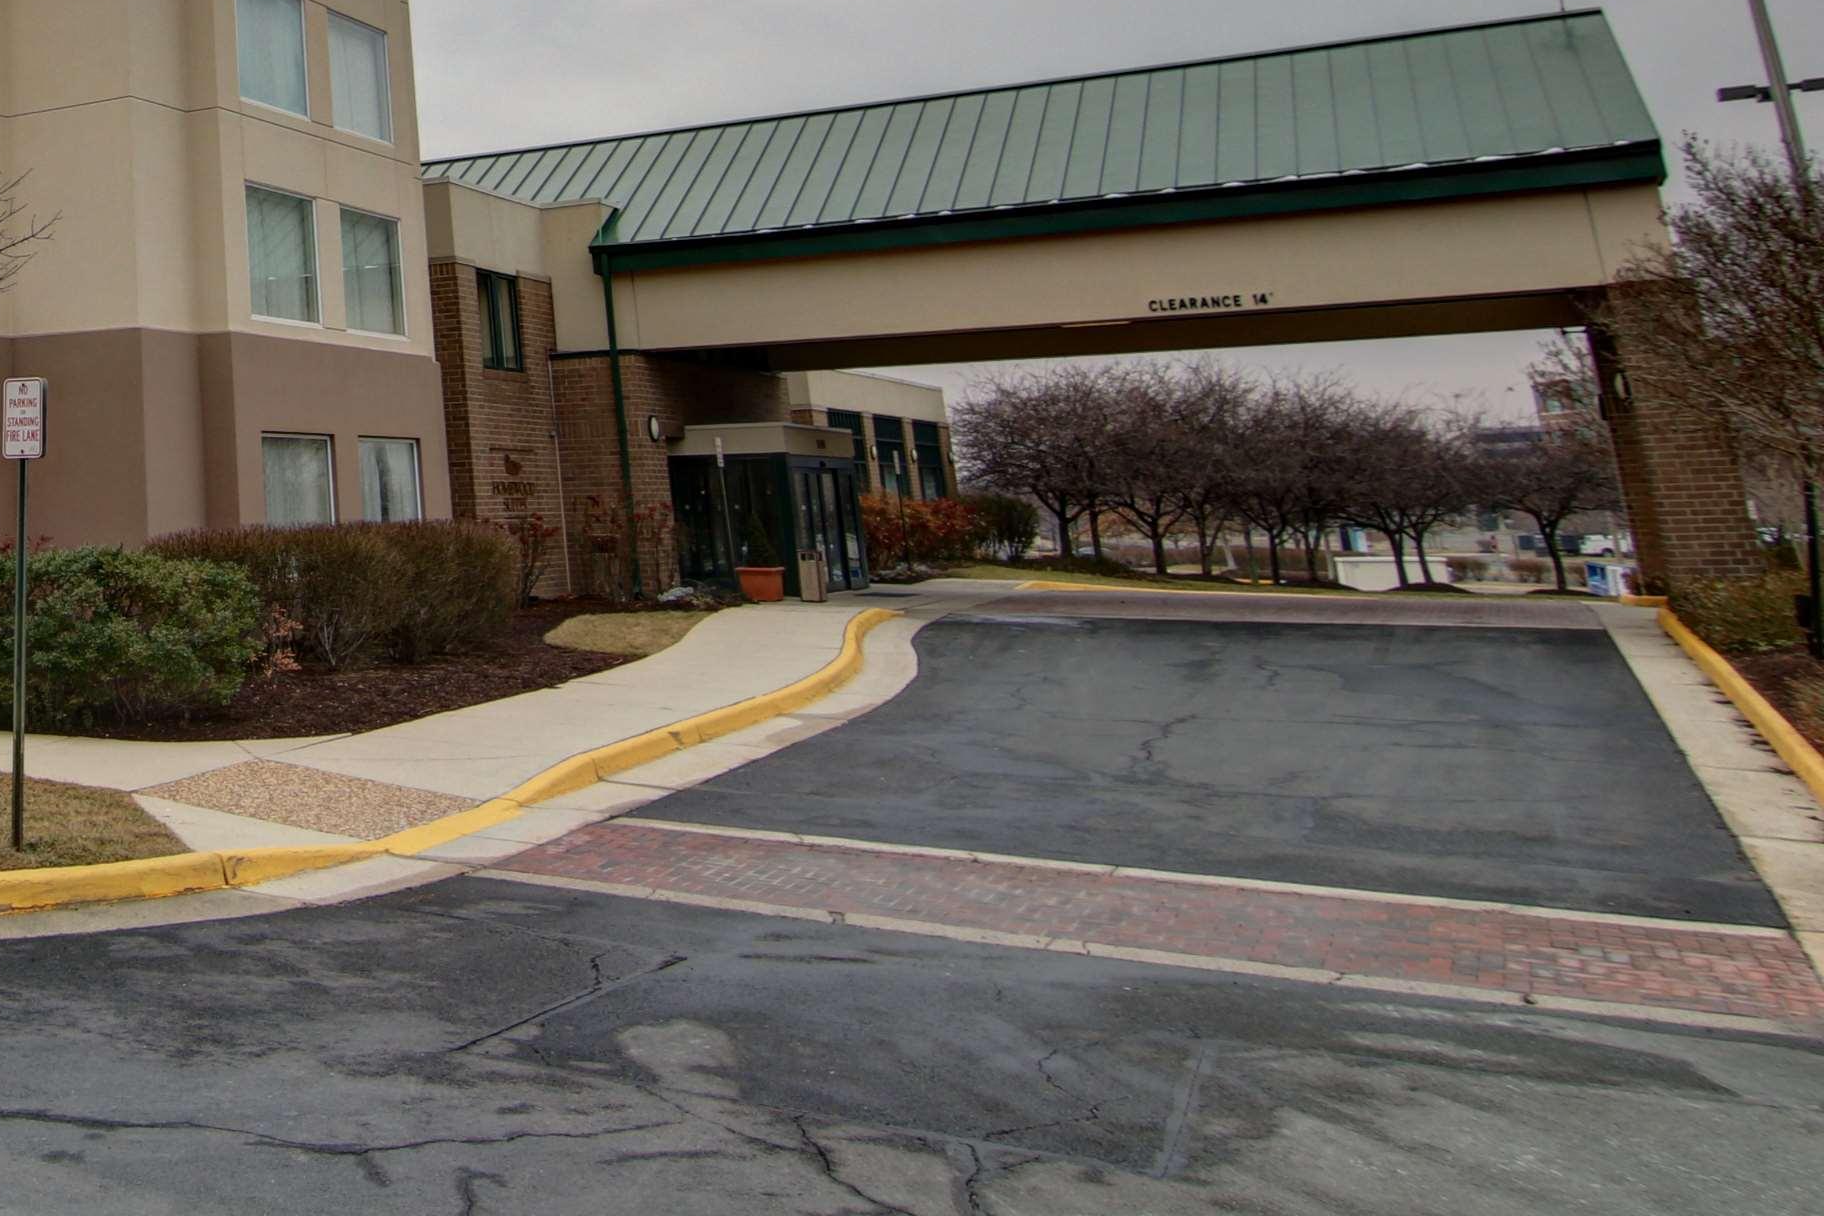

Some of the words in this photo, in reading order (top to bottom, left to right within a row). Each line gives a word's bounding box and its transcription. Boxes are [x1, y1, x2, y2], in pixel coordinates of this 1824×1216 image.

[1148, 294, 1242, 312] CLEARANCE
[18, 385, 29, 396] NO
[9, 397, 38, 409] PARKING
[7, 416, 40, 428] STANDING
[7, 429, 21, 442] FIRE
[22, 429, 40, 442] LANE
